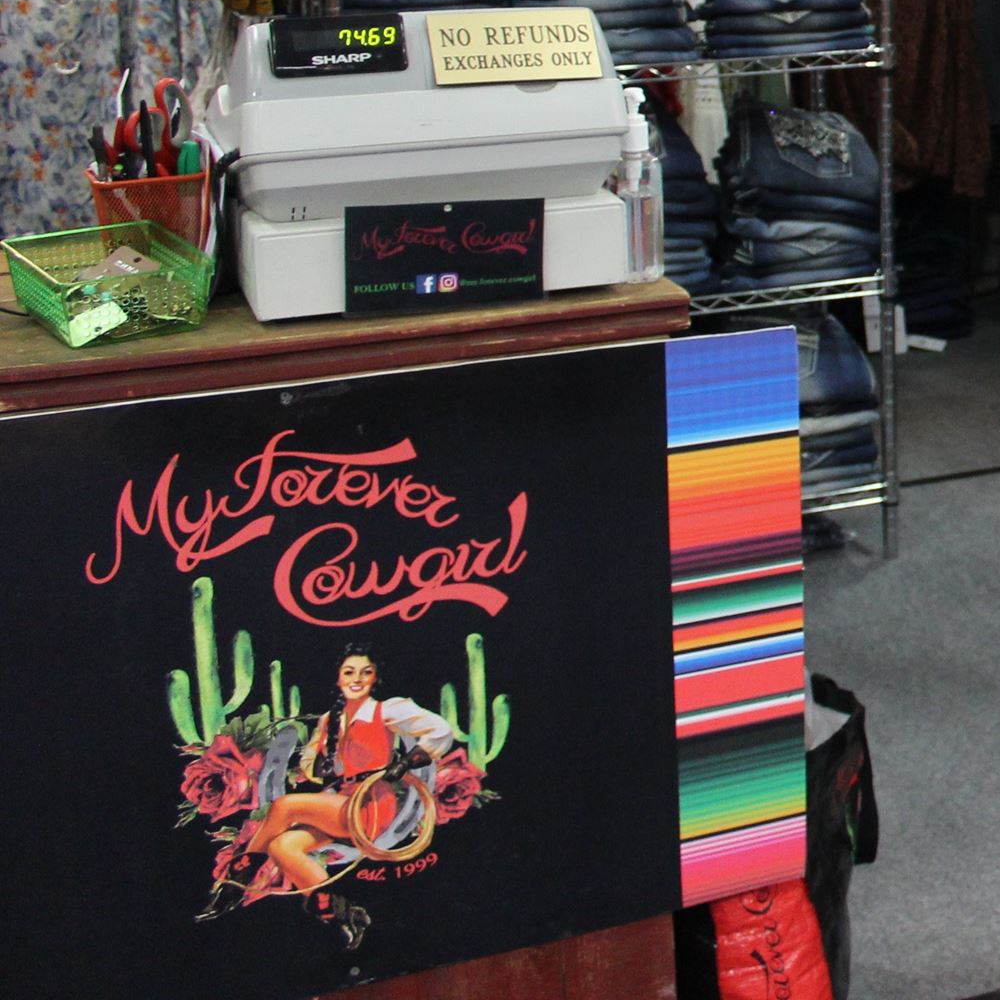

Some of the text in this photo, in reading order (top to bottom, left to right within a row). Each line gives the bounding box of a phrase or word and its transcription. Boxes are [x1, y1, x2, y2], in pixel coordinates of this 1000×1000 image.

[439, 24, 590, 48] NO REFUNDS
[311, 52, 372, 66] SHARP
[443, 51, 593, 71] EXCHANGES ONLY
[353, 225, 406, 261] My
[459, 217, 538, 255] Cowgirl
[354, 283, 400, 294] FOLLOW
[402, 281, 415, 291] US
[86, 430, 460, 584] My Forever
[273, 490, 529, 628] Cowgirl
[356, 851, 439, 881] est. 1999
